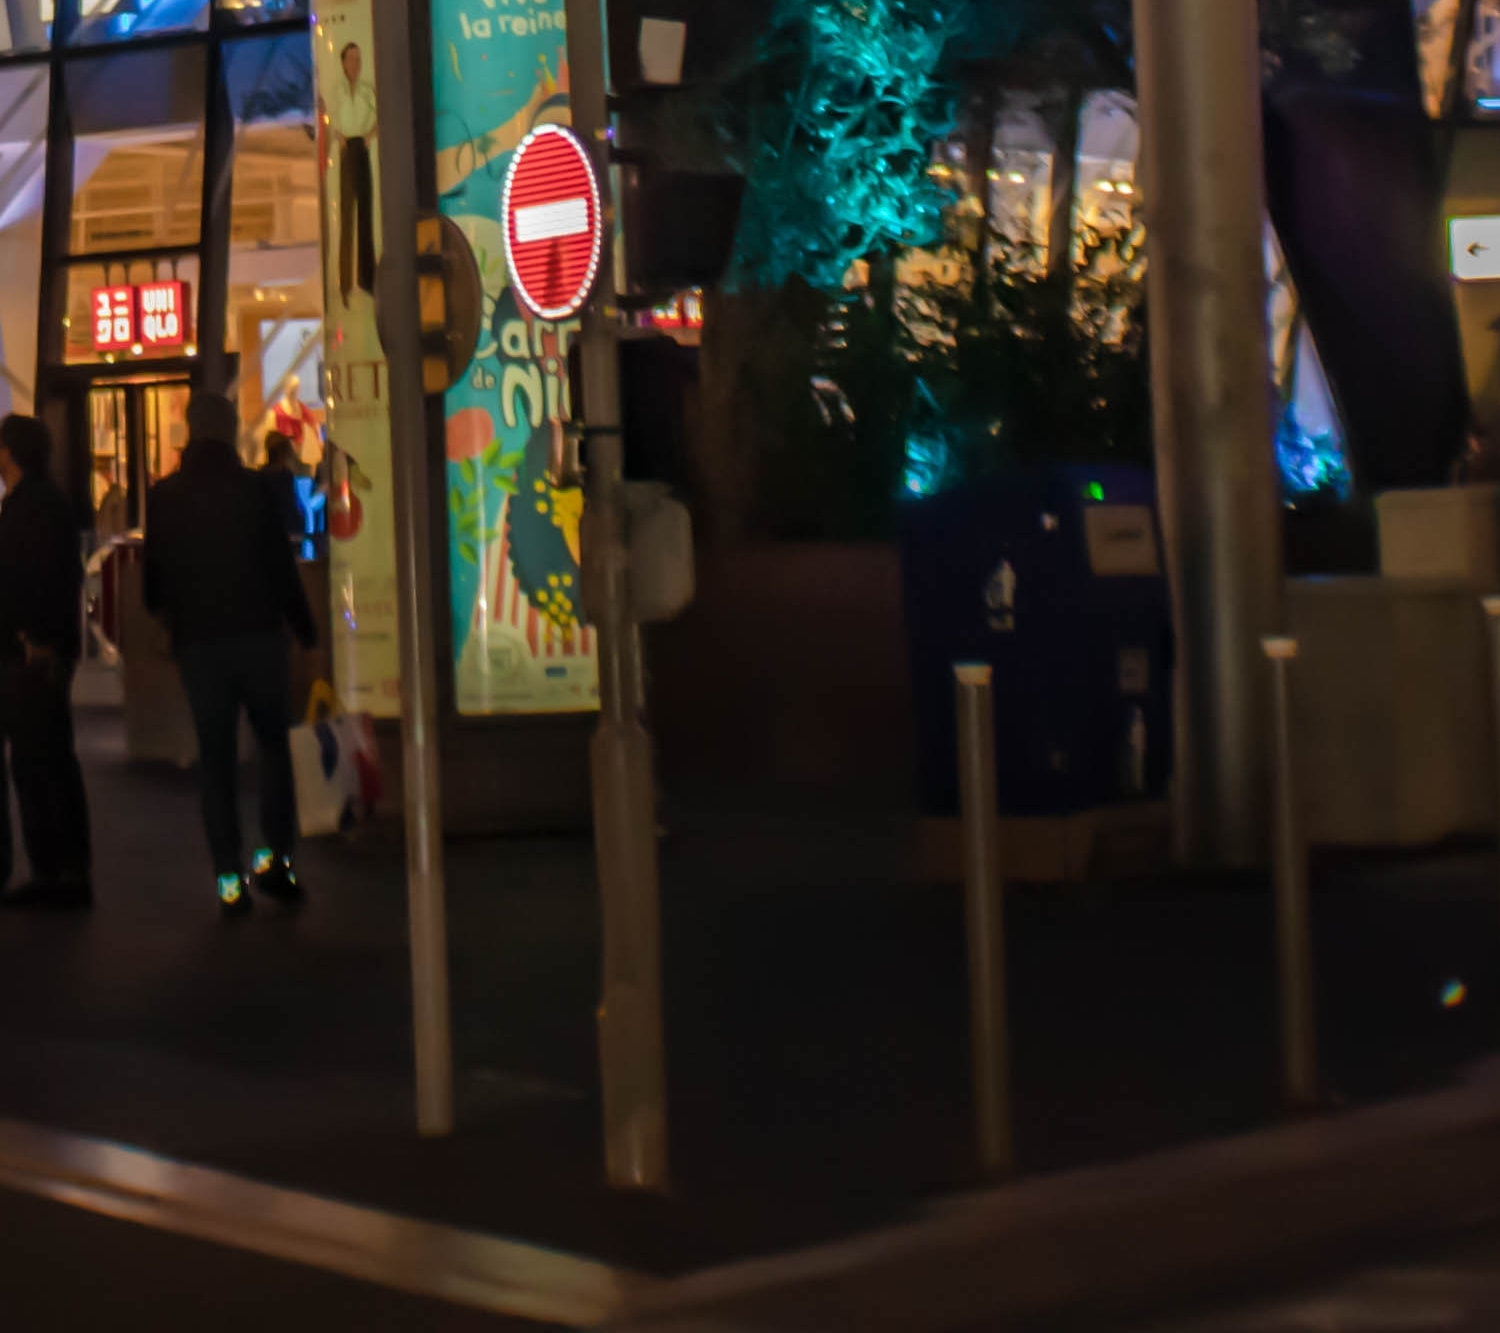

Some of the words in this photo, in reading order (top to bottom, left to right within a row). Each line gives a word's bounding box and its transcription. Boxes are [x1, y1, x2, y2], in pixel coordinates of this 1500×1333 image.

[460, 12, 492, 40] la
[498, 7, 567, 37] reine
[472, 364, 496, 390] de
